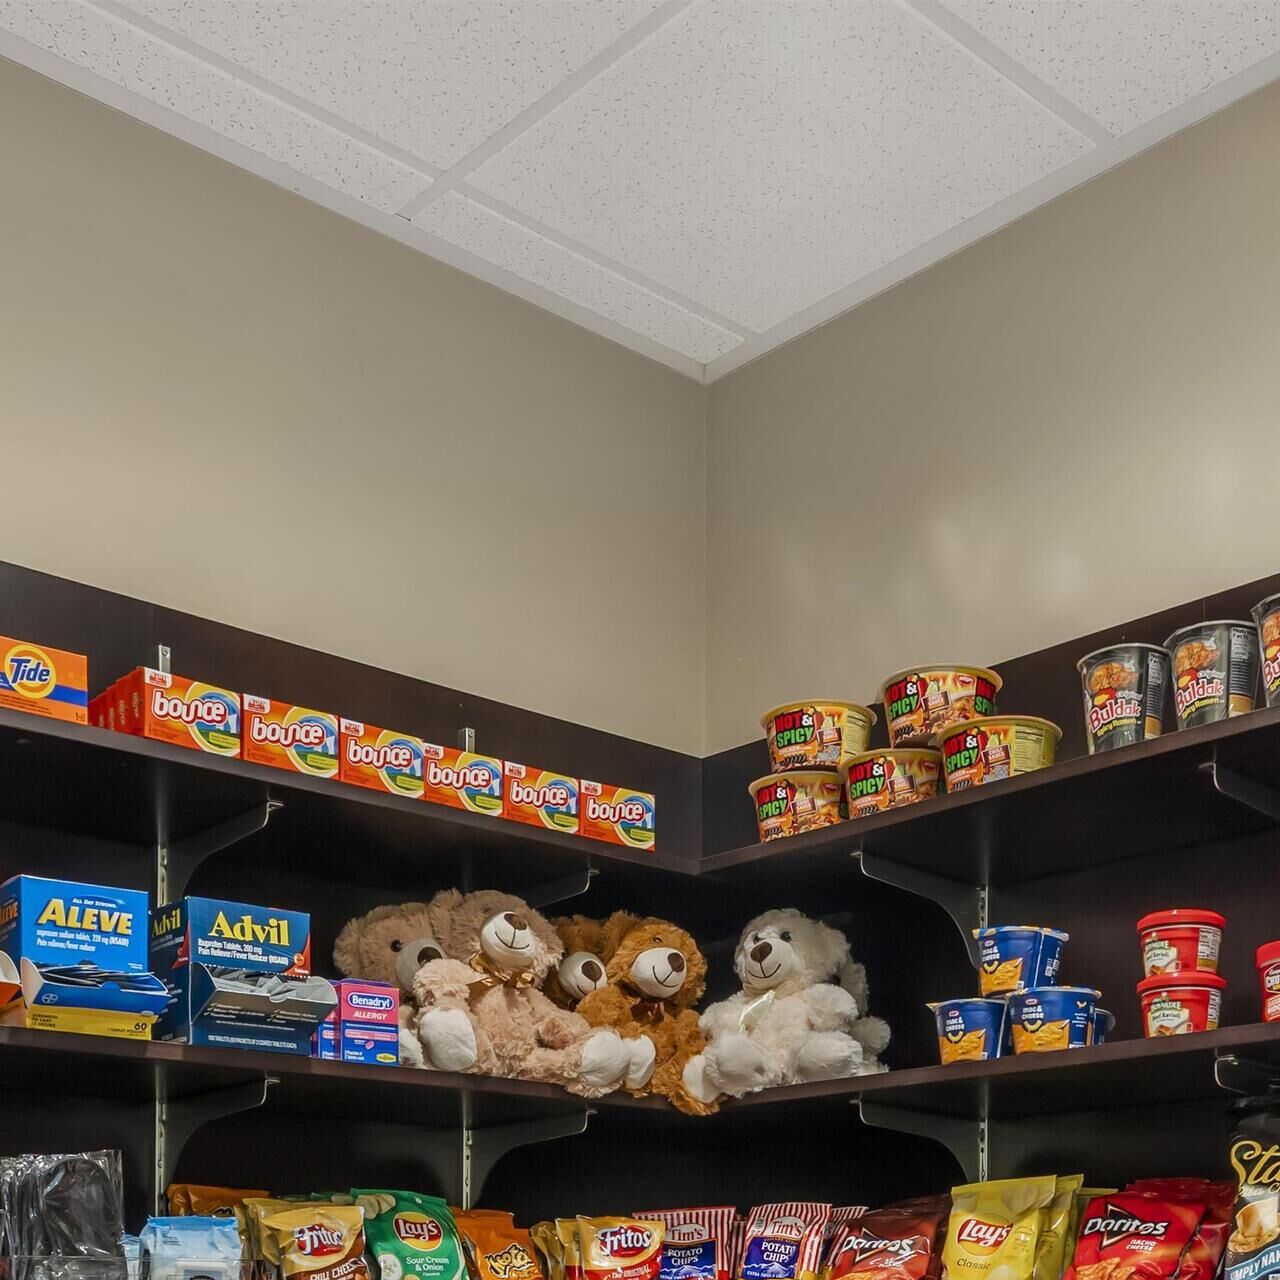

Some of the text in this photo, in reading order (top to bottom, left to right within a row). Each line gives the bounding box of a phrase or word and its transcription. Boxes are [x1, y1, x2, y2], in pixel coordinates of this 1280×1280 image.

[9, 657, 51, 684] Tide
[152, 689, 228, 723] bounce
[1175, 679, 1224, 716] Buldak
[775, 711, 813, 732] HOT &
[1090, 700, 1142, 733] Buldak
[251, 716, 326, 748] bounce
[776, 726, 814, 748] SPICY
[348, 738, 413, 768] bounce
[944, 734, 978, 754] HOT &
[946, 748, 978, 772] SPICY
[427, 760, 492, 790] bounce
[510, 779, 569, 808] bounce
[587, 797, 645, 824] bounce
[37, 898, 133, 935] ALEVE
[208, 911, 290, 946] Advil
[351, 994, 391, 1008] Benadryl
[134, 1022, 147, 1030] 60
[353, 1010, 388, 1020] ALLERGY
[398, 1218, 441, 1240] Lay's
[671, 1228, 703, 1241] Tim's
[771, 1220, 803, 1237] Tim's
[961, 1219, 1011, 1243] Lay's
[1084, 1216, 1169, 1236] Doritos
[601, 1226, 651, 1256] Fritos
[761, 1242, 797, 1253] POTATO
[406, 1257, 449, 1265] Sour Cream
[668, 1248, 703, 1257] POTATO
[671, 1256, 699, 1266] CHIPS
[764, 1251, 789, 1263] CHIPS
[957, 1257, 991, 1270] Classic
[423, 1263, 444, 1271] Onion
